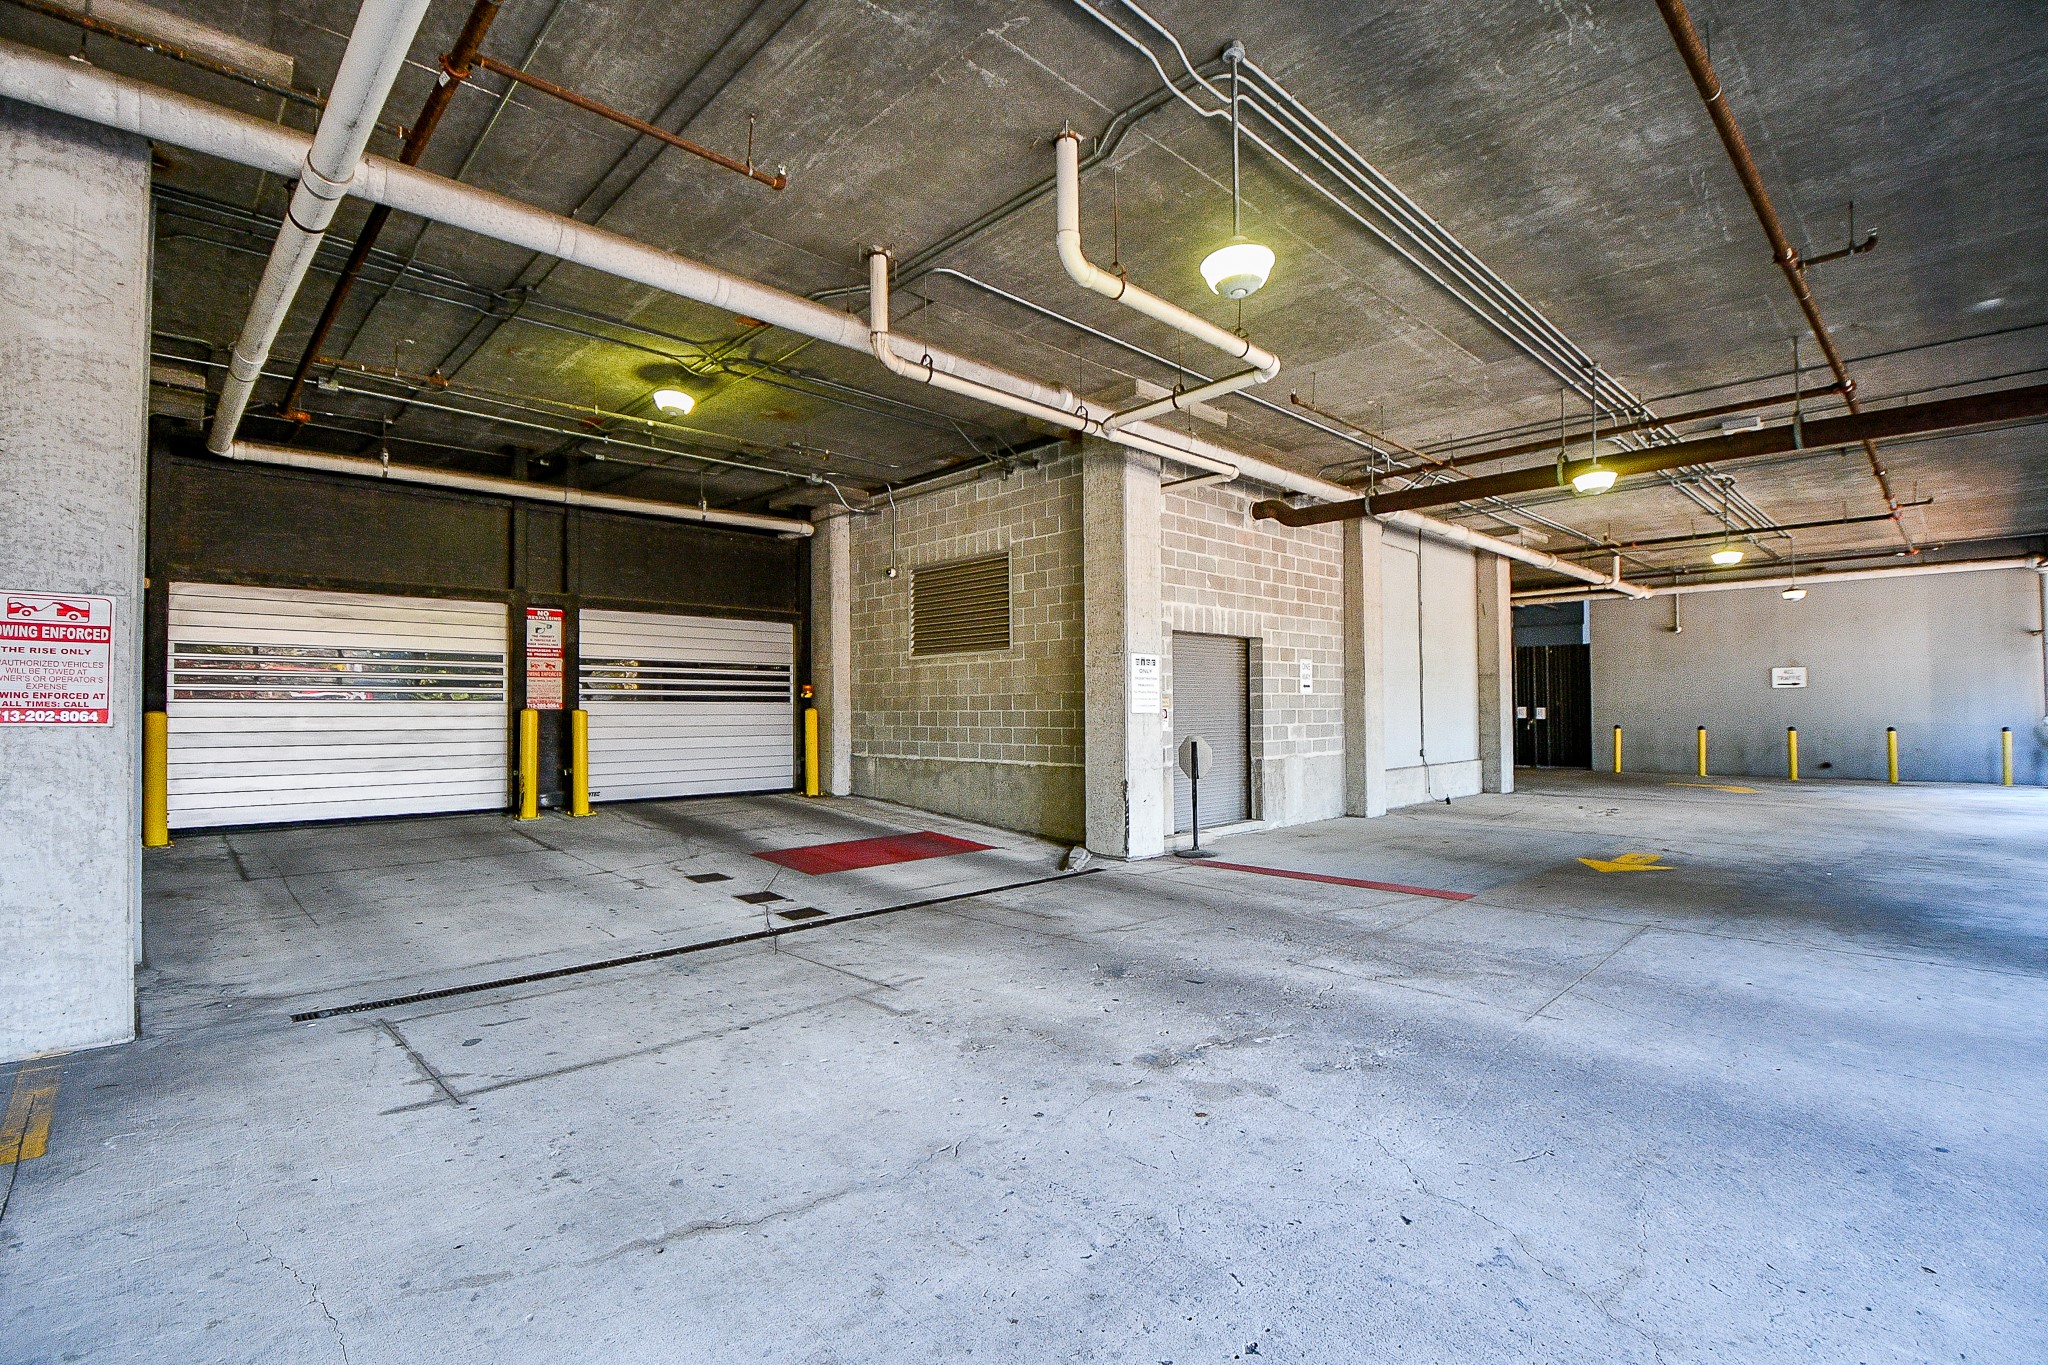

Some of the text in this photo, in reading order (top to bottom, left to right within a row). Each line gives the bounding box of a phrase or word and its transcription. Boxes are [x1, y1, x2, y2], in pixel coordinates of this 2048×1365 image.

[0, 624, 109, 640] WING ENFORCED
[1, 645, 91, 656] THE RISE ONLY
[61, 661, 104, 669] VEHICLES
[5, 667, 27, 675] WILL
[43, 668, 76, 676] TOWED
[32, 675, 47, 683] OR
[25, 682, 68, 691] EXPENSE
[32, 692, 90, 700] ENFORCED
[25, 700, 60, 708] TIMES:
[0, 710, 99, 722] 13-202-8064
